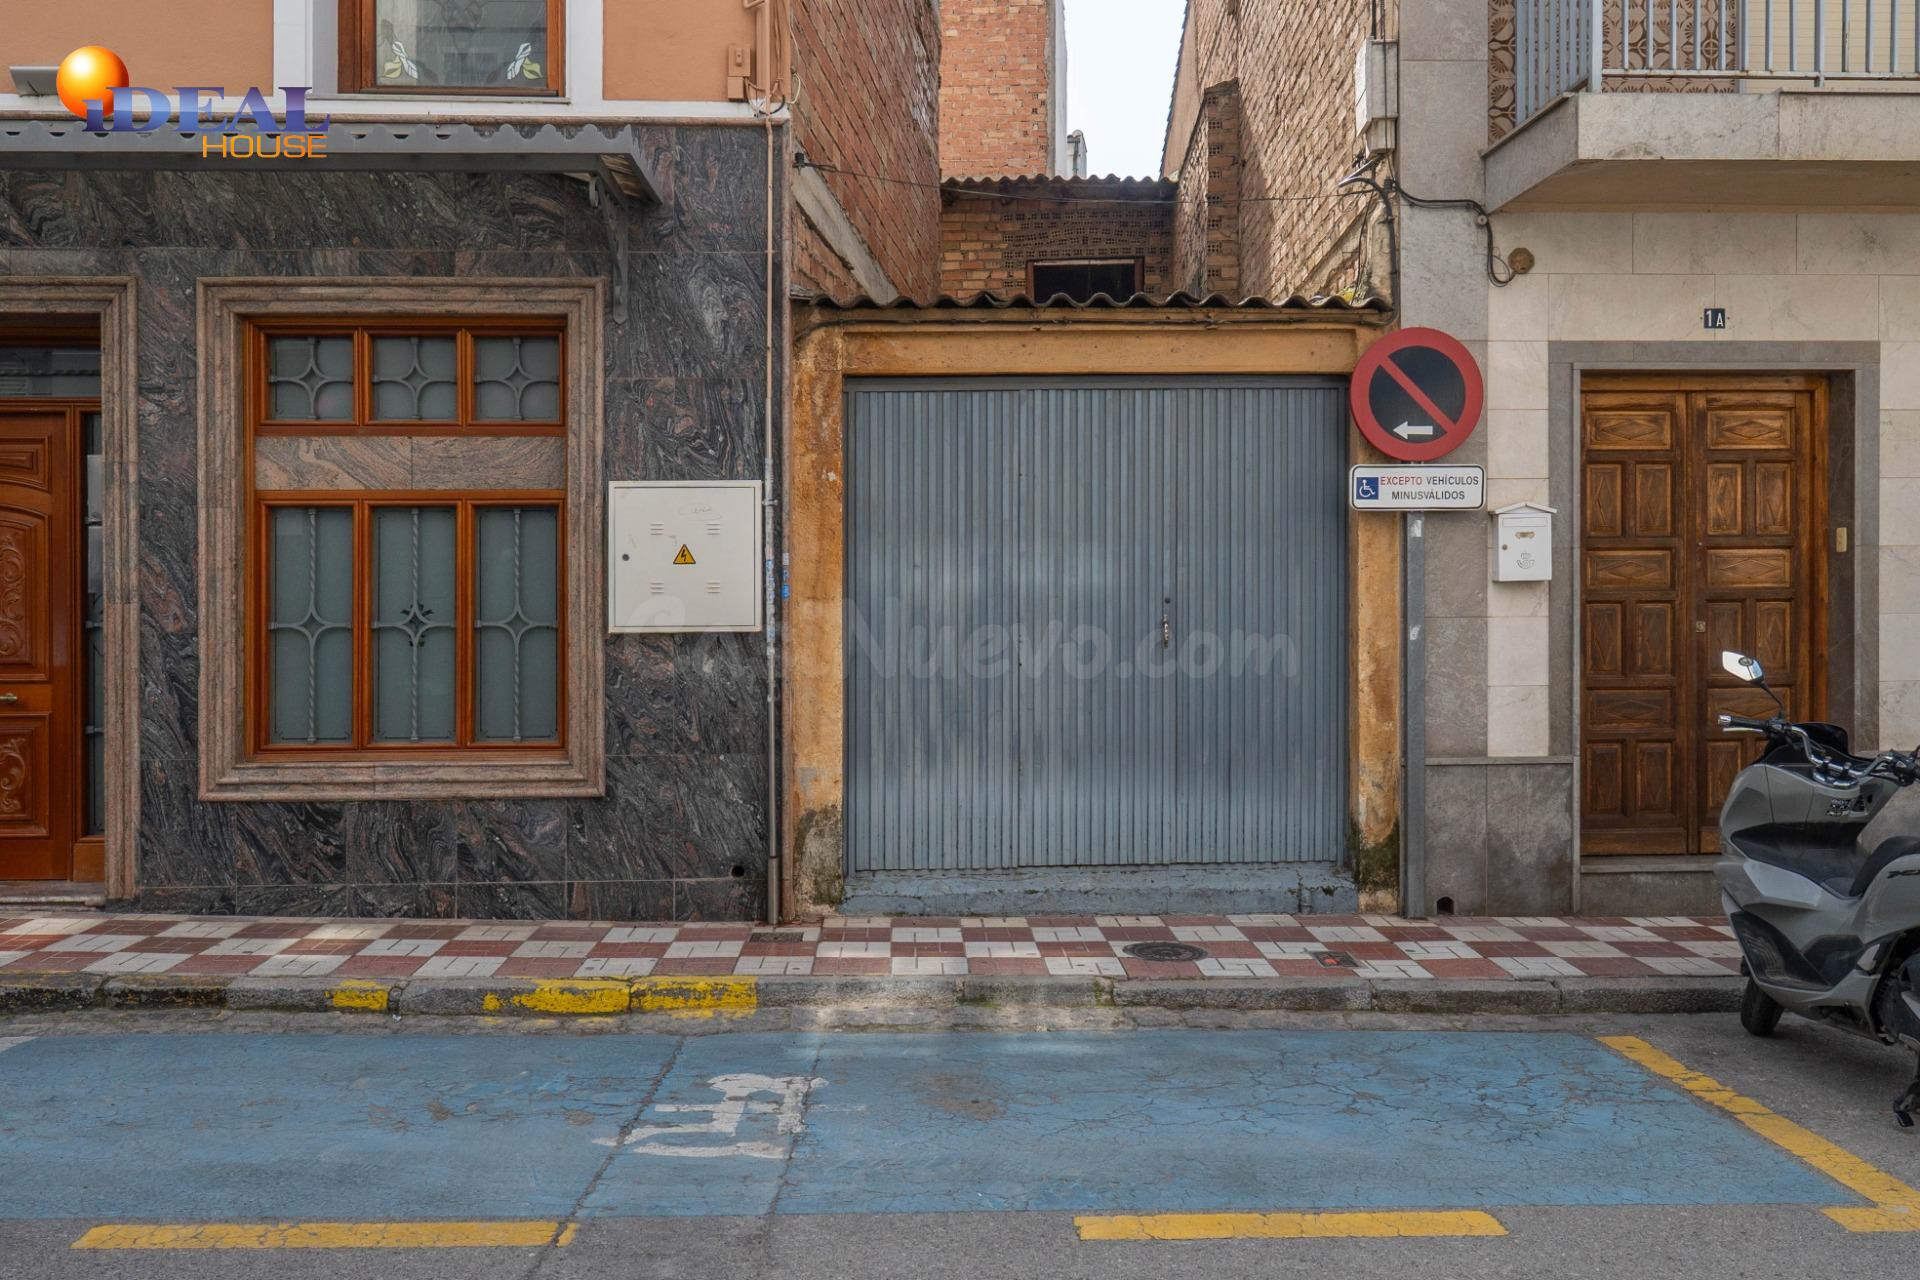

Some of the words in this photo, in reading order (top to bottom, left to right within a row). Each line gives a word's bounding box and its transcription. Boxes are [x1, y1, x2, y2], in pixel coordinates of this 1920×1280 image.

[1380, 476, 1422, 486] EXCEPTO
[1426, 474, 1479, 486] VEHÍCULOS
[1391, 489, 1465, 500] MINUSVÁLIDOS
